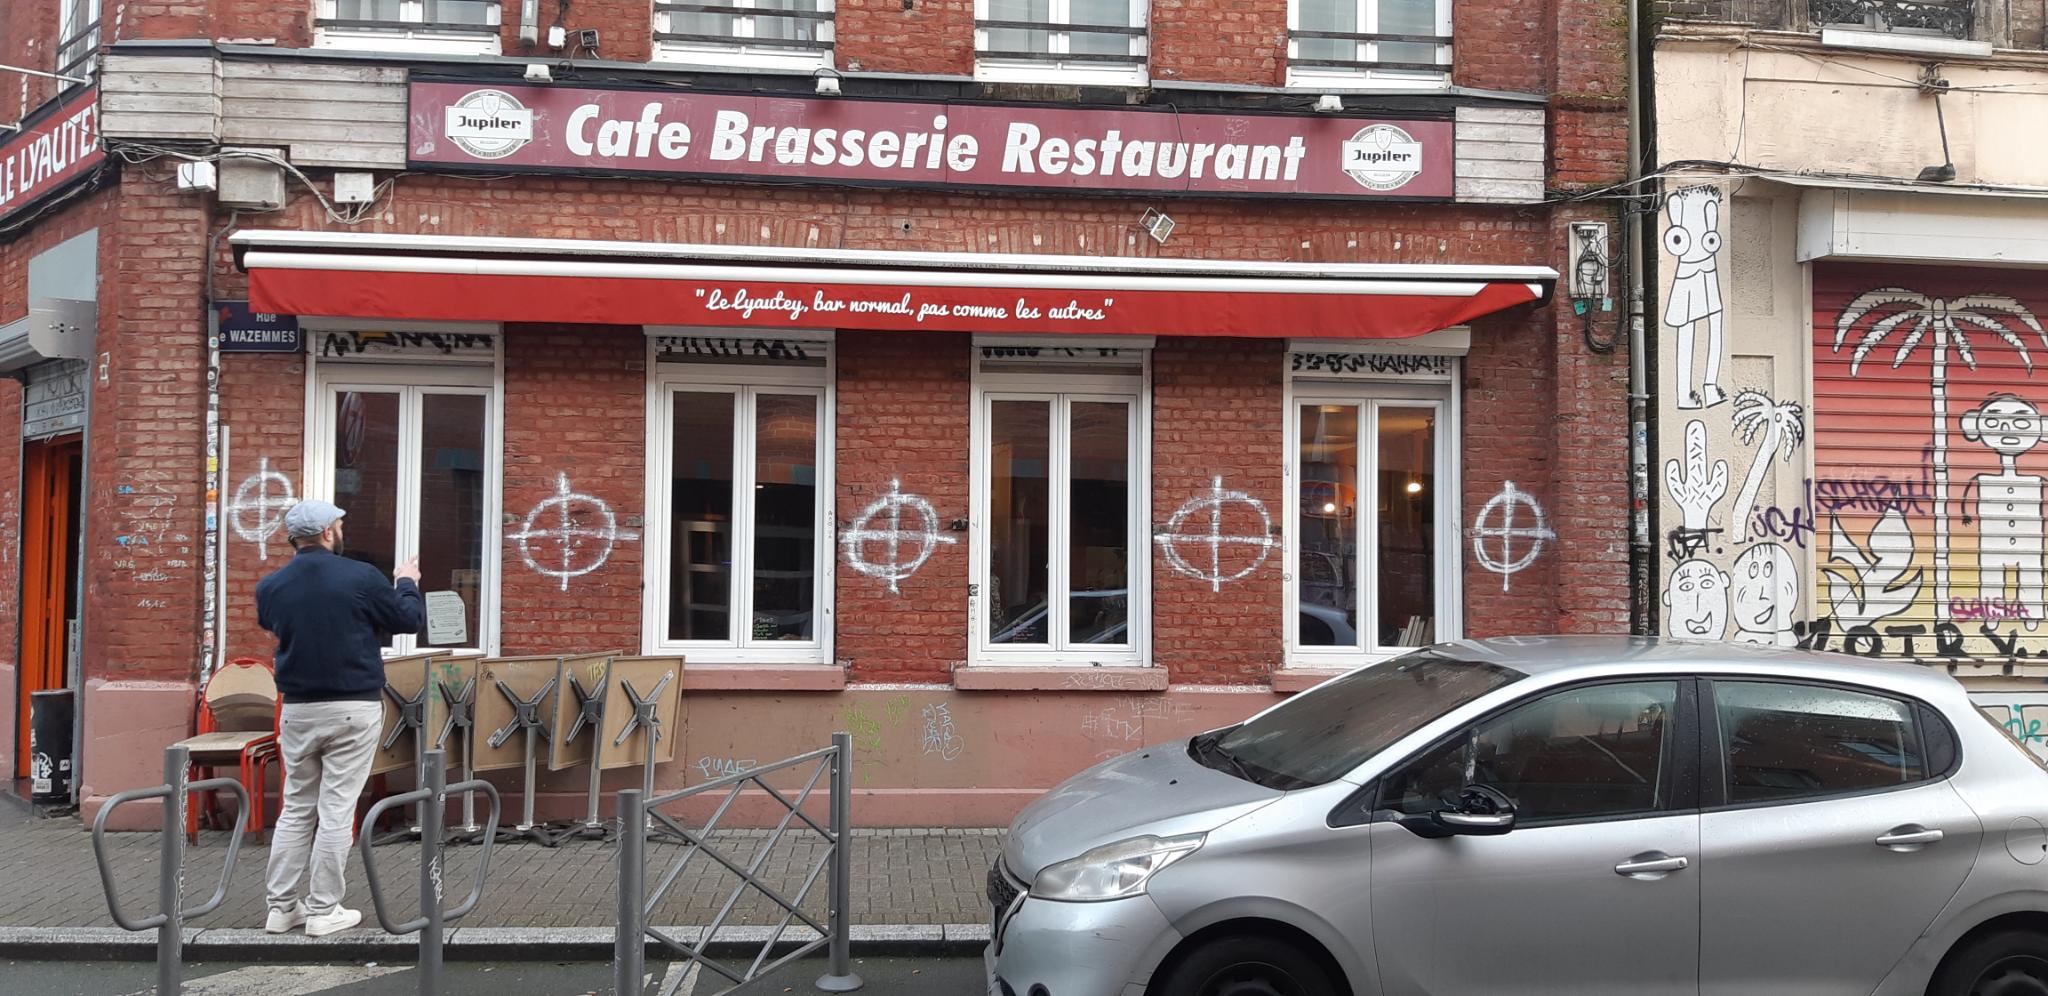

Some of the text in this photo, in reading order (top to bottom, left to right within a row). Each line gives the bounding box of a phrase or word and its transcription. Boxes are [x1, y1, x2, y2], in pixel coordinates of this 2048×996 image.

[457, 115, 521, 131] Jupiler
[565, 102, 1306, 181] Cafe Brasserie Restaurant
[1353, 149, 1412, 164] Jupiler
[0, 155, 15, 206] LE
[813, 290, 845, 311] bar
[850, 292, 914, 316] normal,
[917, 302, 950, 321] pas
[952, 303, 1008, 319] comme
[1015, 298, 1042, 319] les
[1048, 298, 1113, 320] autres"
[256, 313, 277, 322] Rue
[229, 330, 296, 343] WAZEMMES
